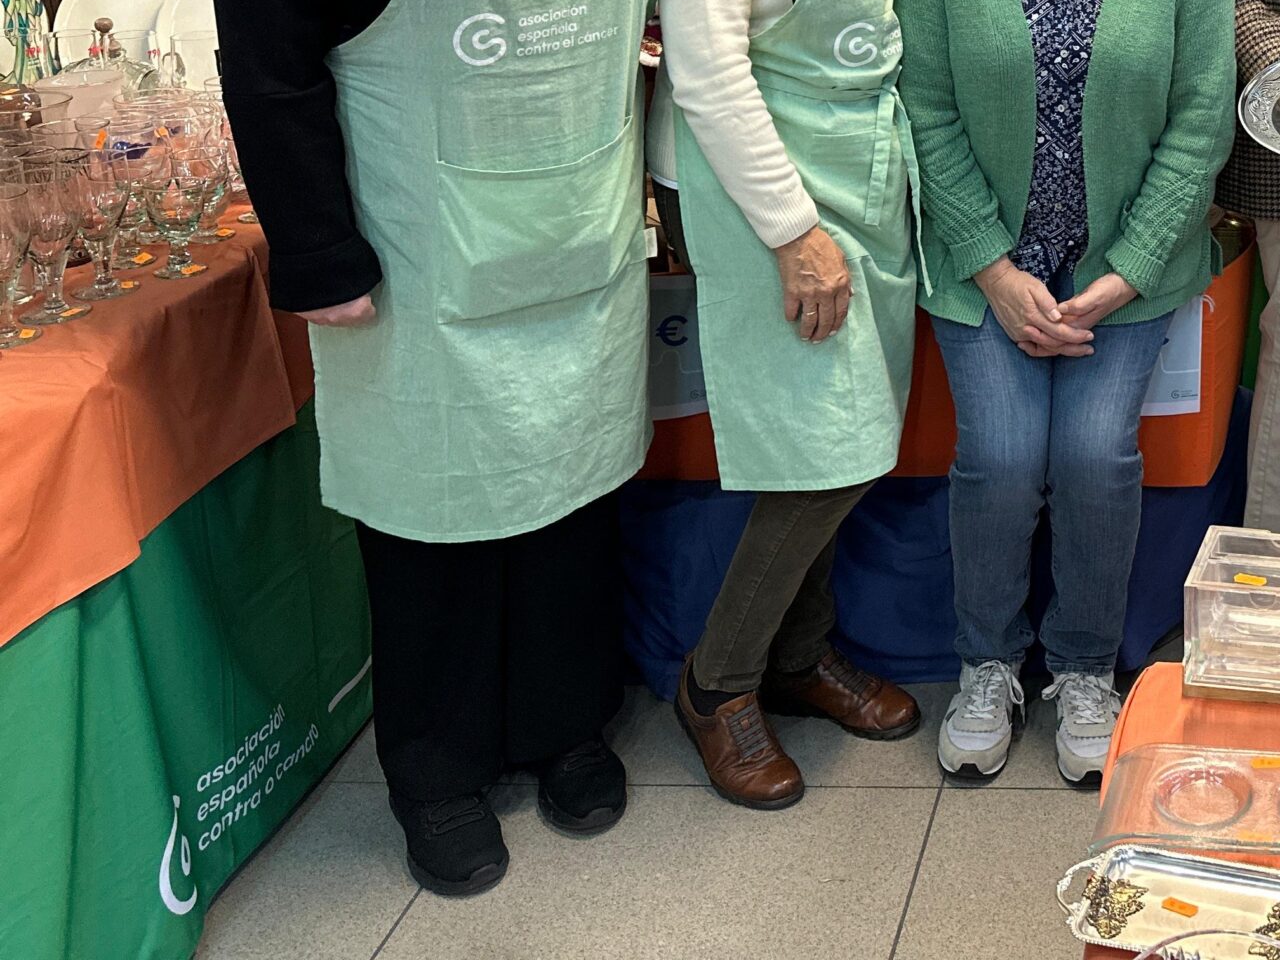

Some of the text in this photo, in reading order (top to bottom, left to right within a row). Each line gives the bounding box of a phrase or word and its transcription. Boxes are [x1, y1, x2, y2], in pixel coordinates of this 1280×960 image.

[516, 25, 619, 58] contra el cáncer
[517, 21, 578, 44] española
[518, 4, 588, 28] asociación
[196, 703, 286, 793] asociación
[196, 740, 281, 821] española
[198, 723, 320, 851] contra o cancro
